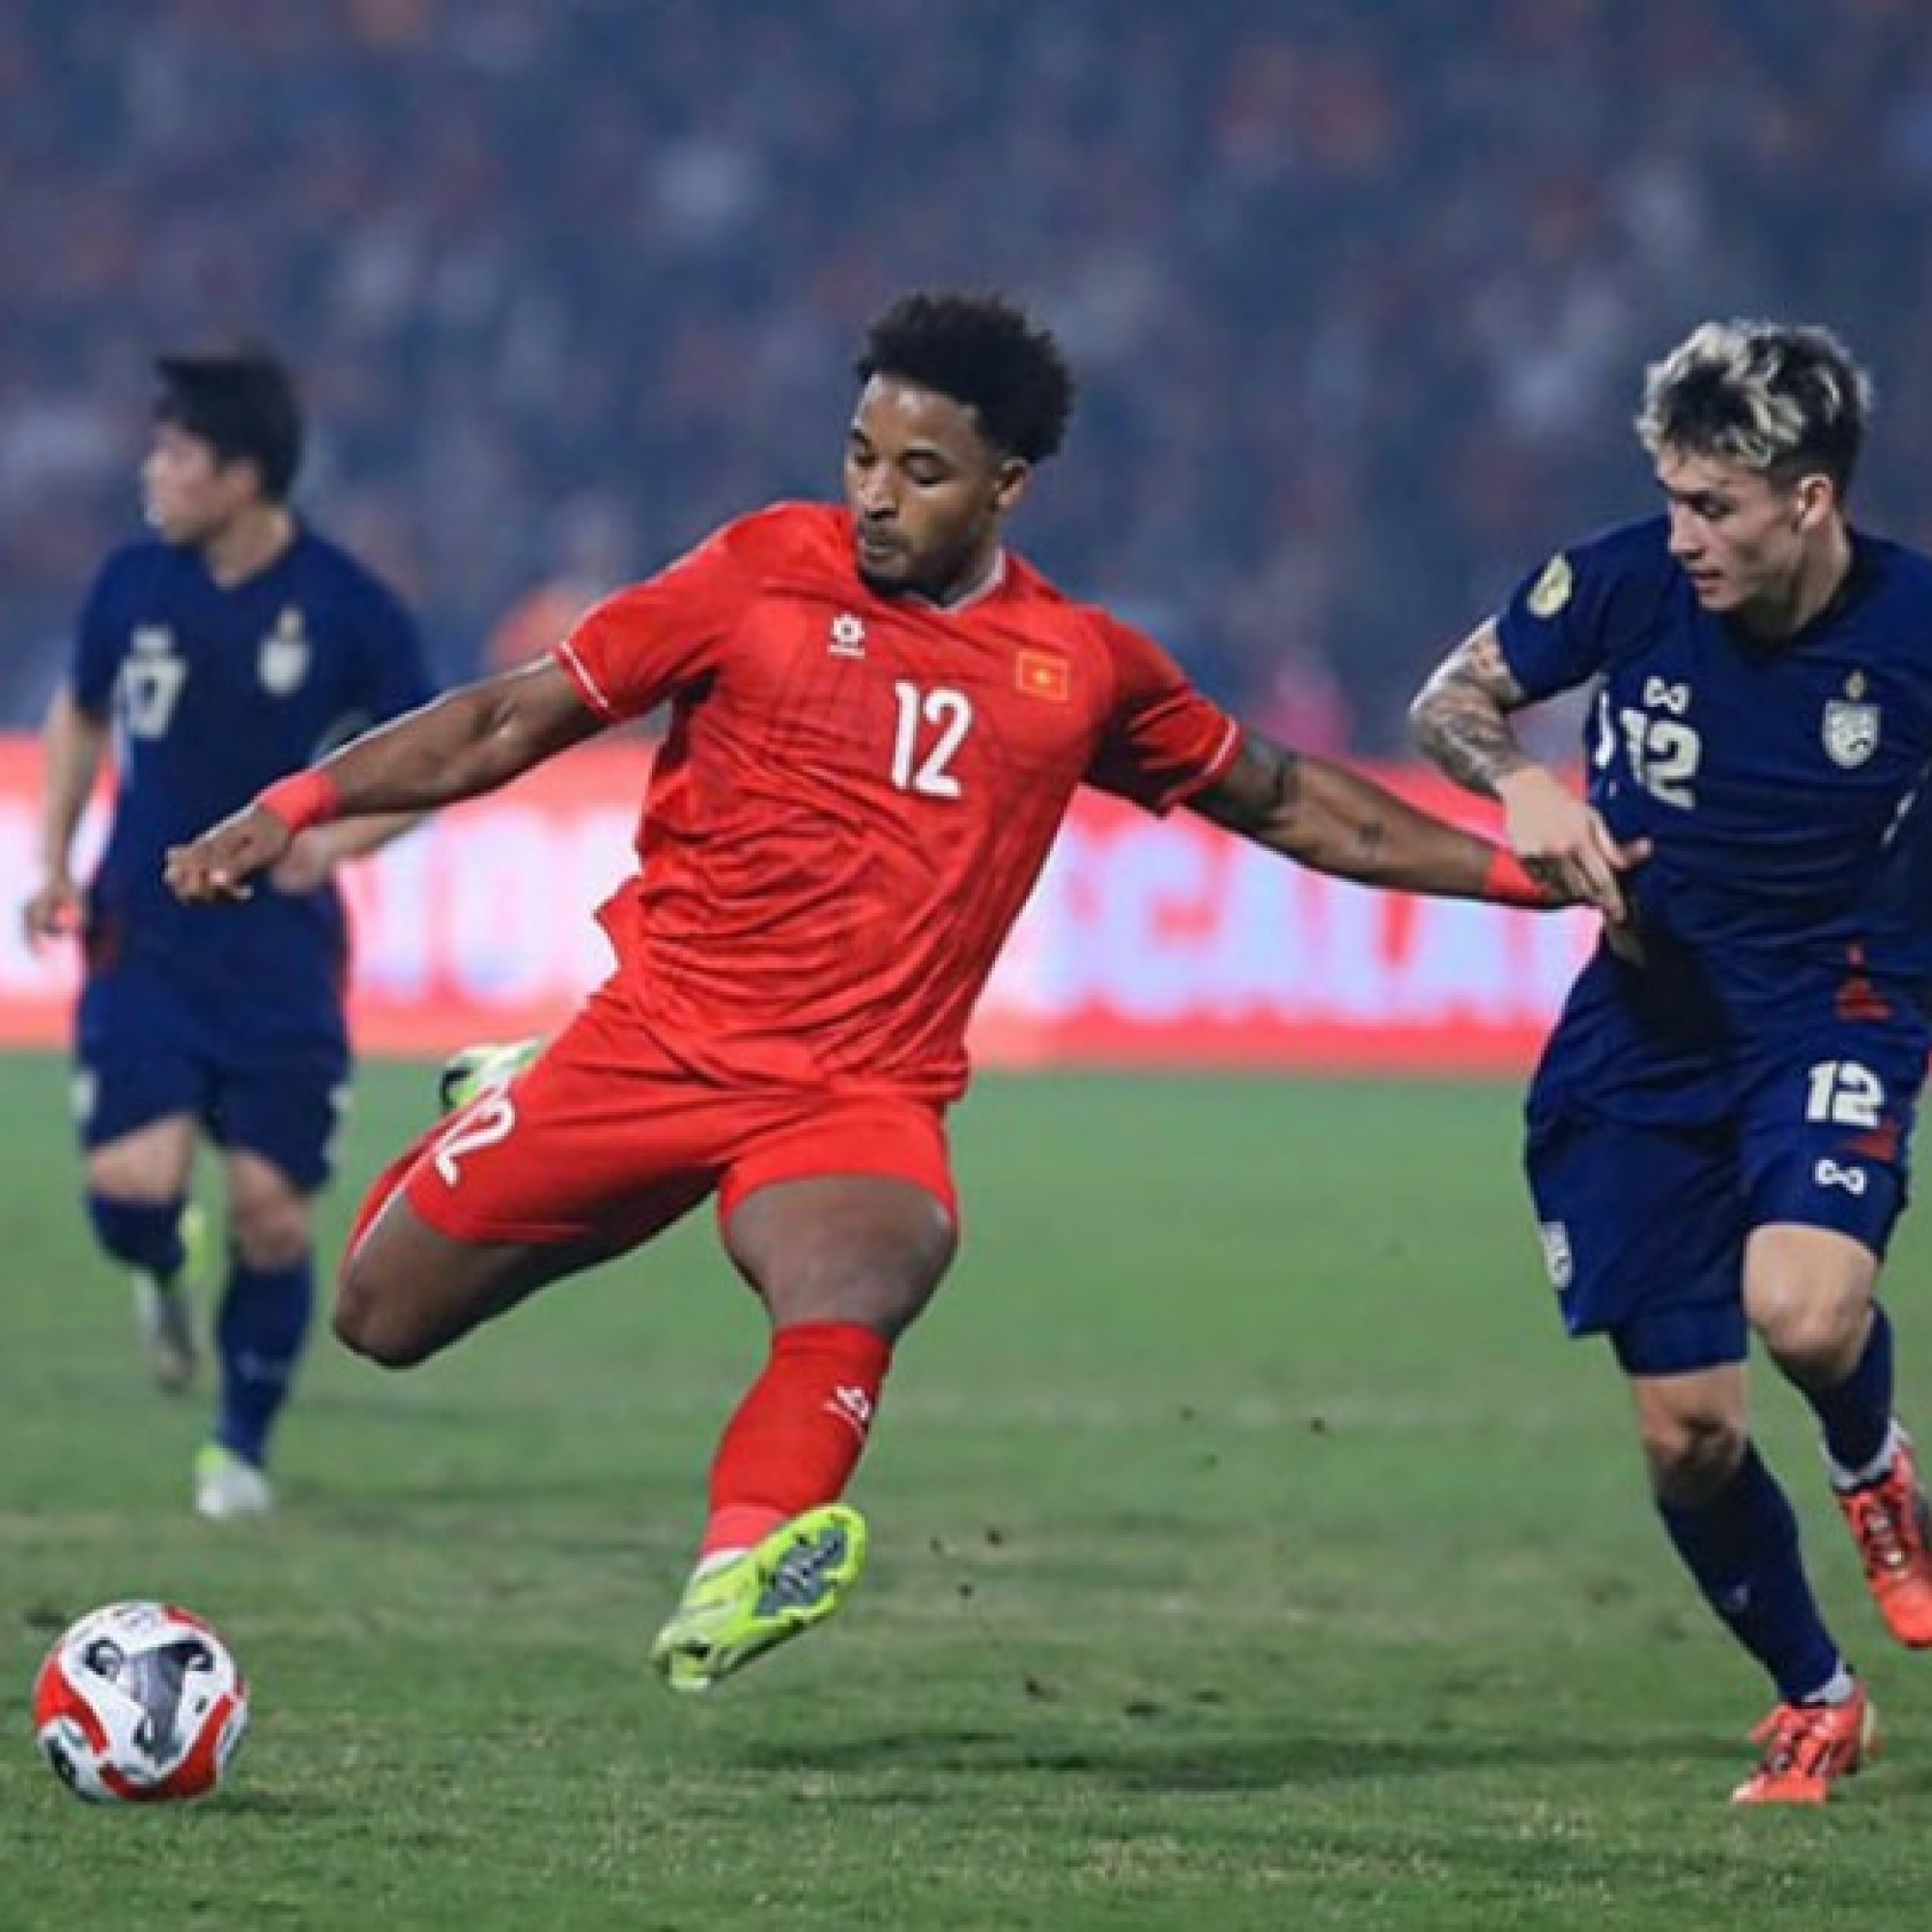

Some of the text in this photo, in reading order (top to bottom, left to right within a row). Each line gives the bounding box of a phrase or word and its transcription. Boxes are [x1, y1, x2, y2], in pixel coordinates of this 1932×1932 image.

[891, 679, 974, 798] 12
[1619, 707, 1702, 810] 12
[1804, 1060, 1885, 1127] 12
